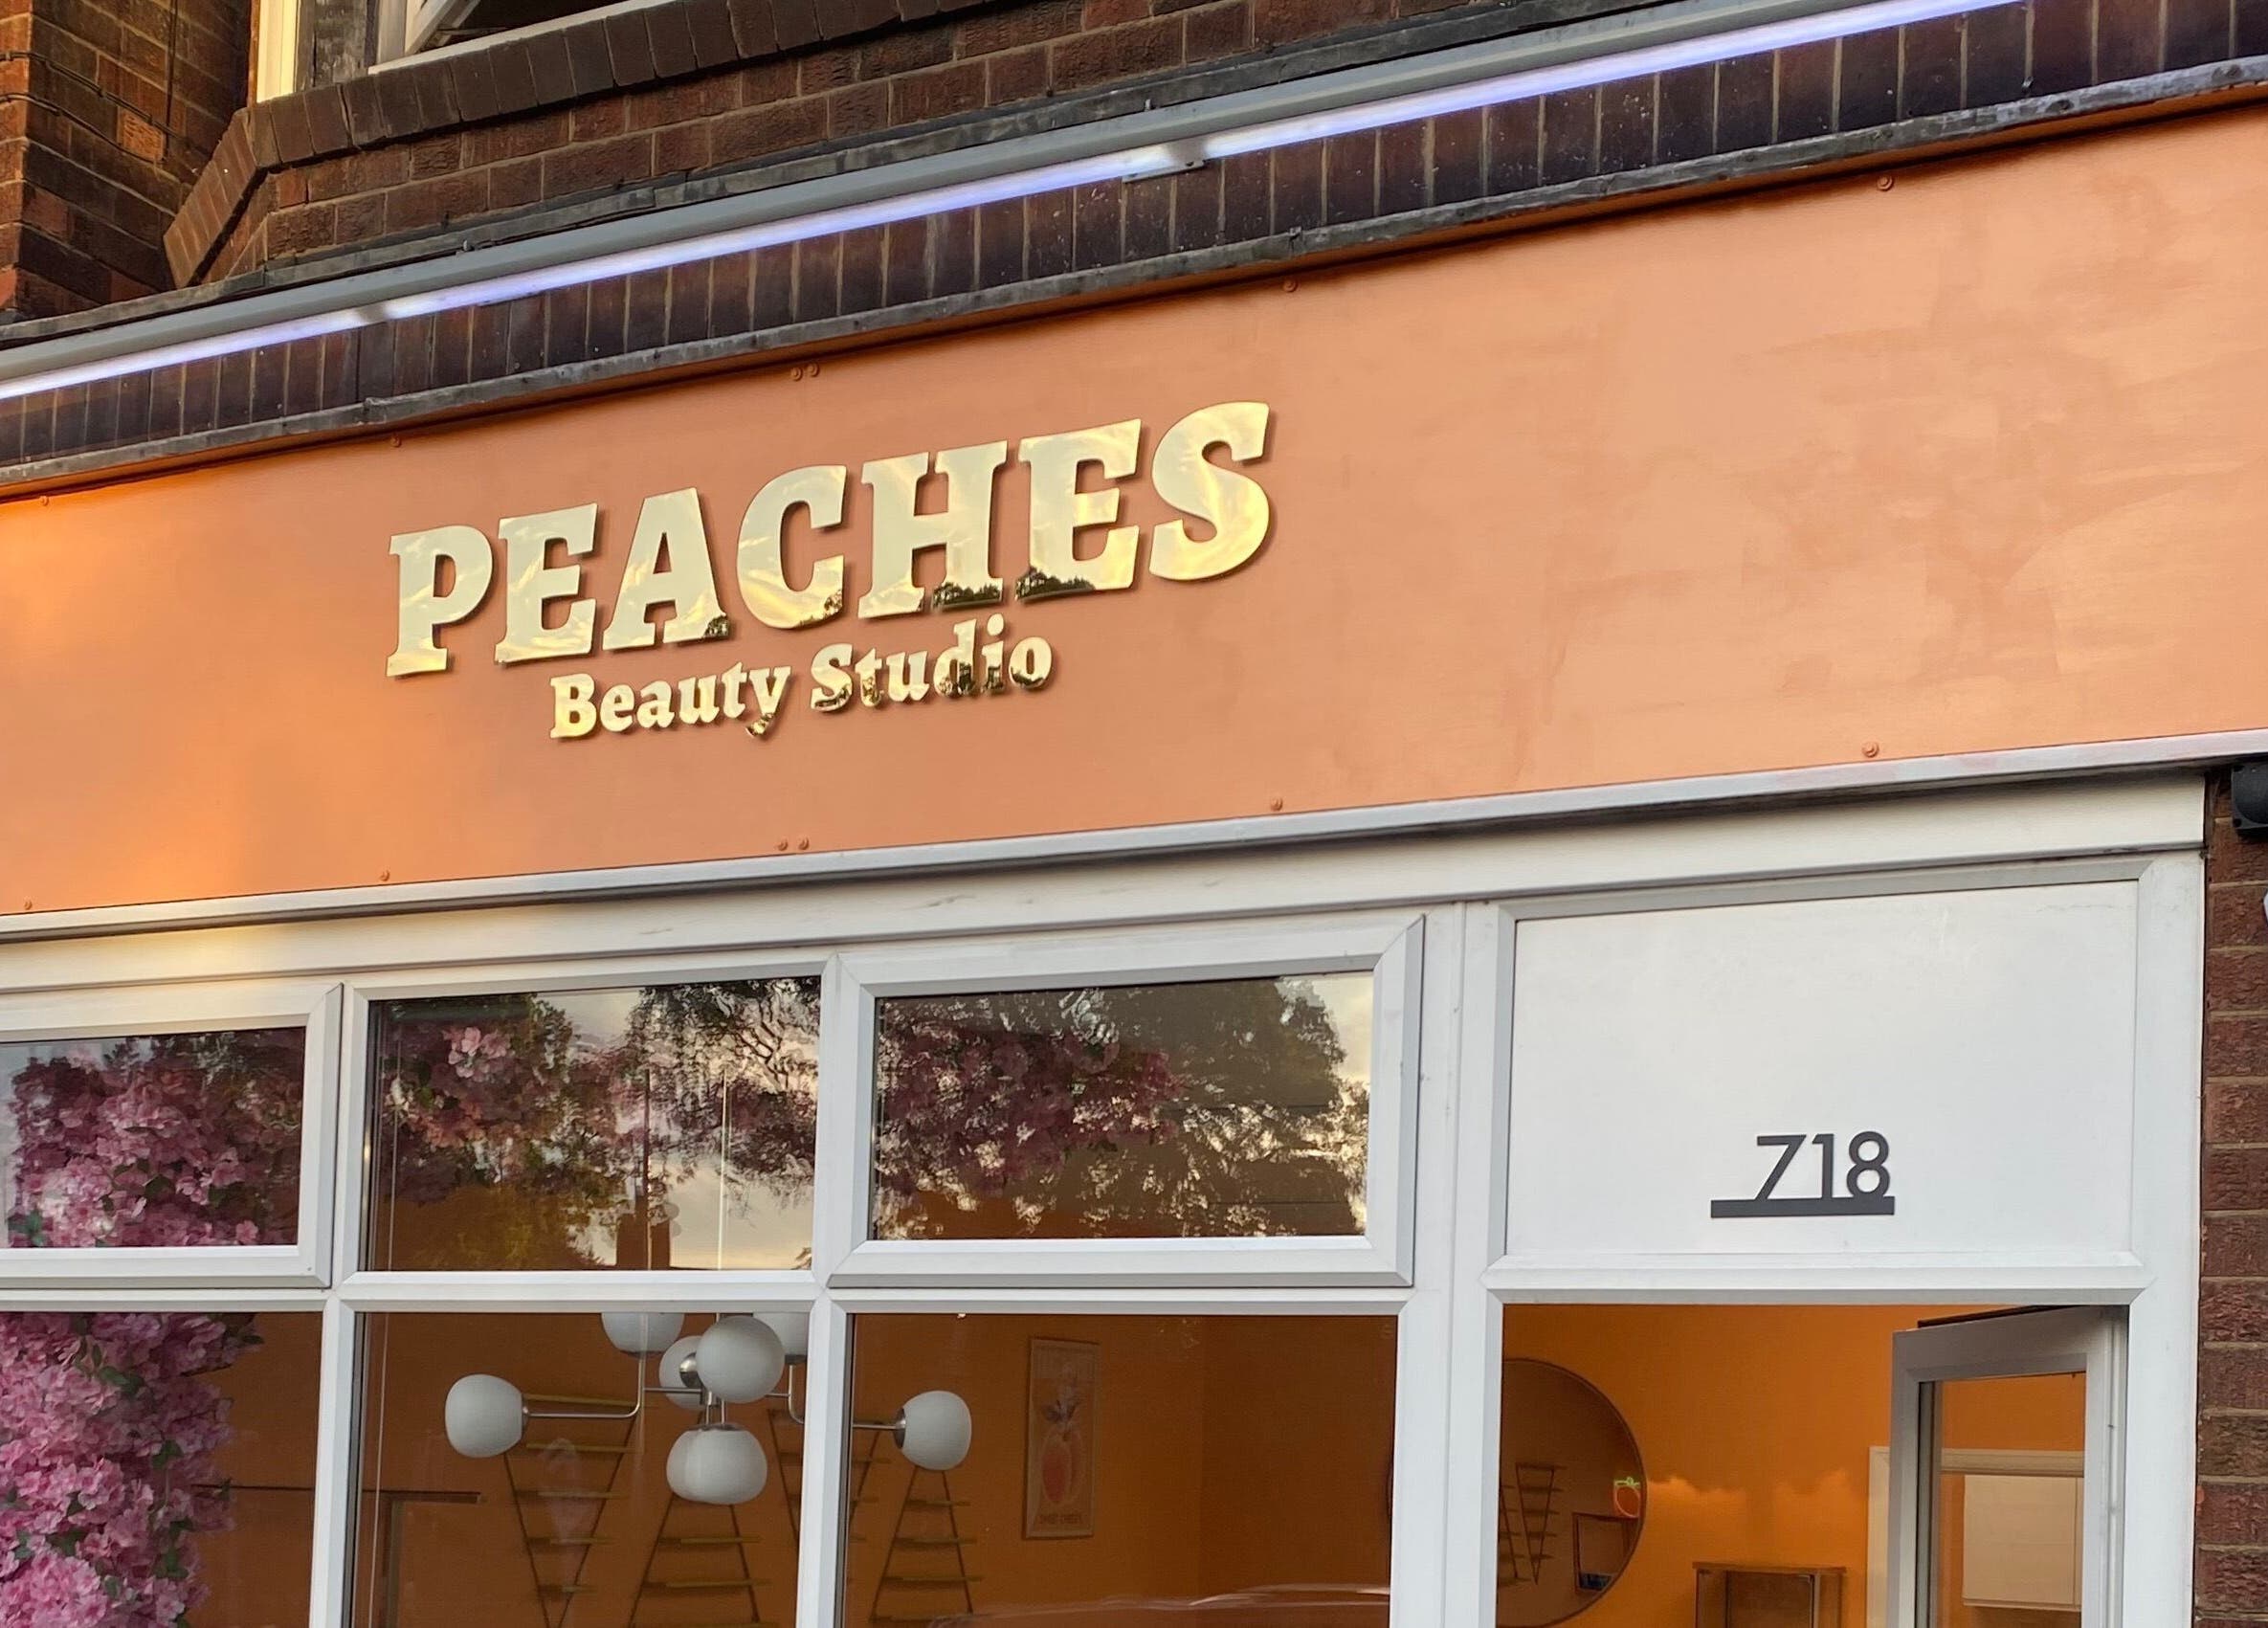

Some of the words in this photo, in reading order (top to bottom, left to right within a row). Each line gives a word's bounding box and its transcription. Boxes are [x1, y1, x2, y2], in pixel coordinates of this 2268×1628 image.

[386, 401, 1272, 677] PEACHES
[549, 661, 791, 739] Beauty
[810, 613, 1054, 714] Studio
[1754, 1130, 1891, 1200] 718
